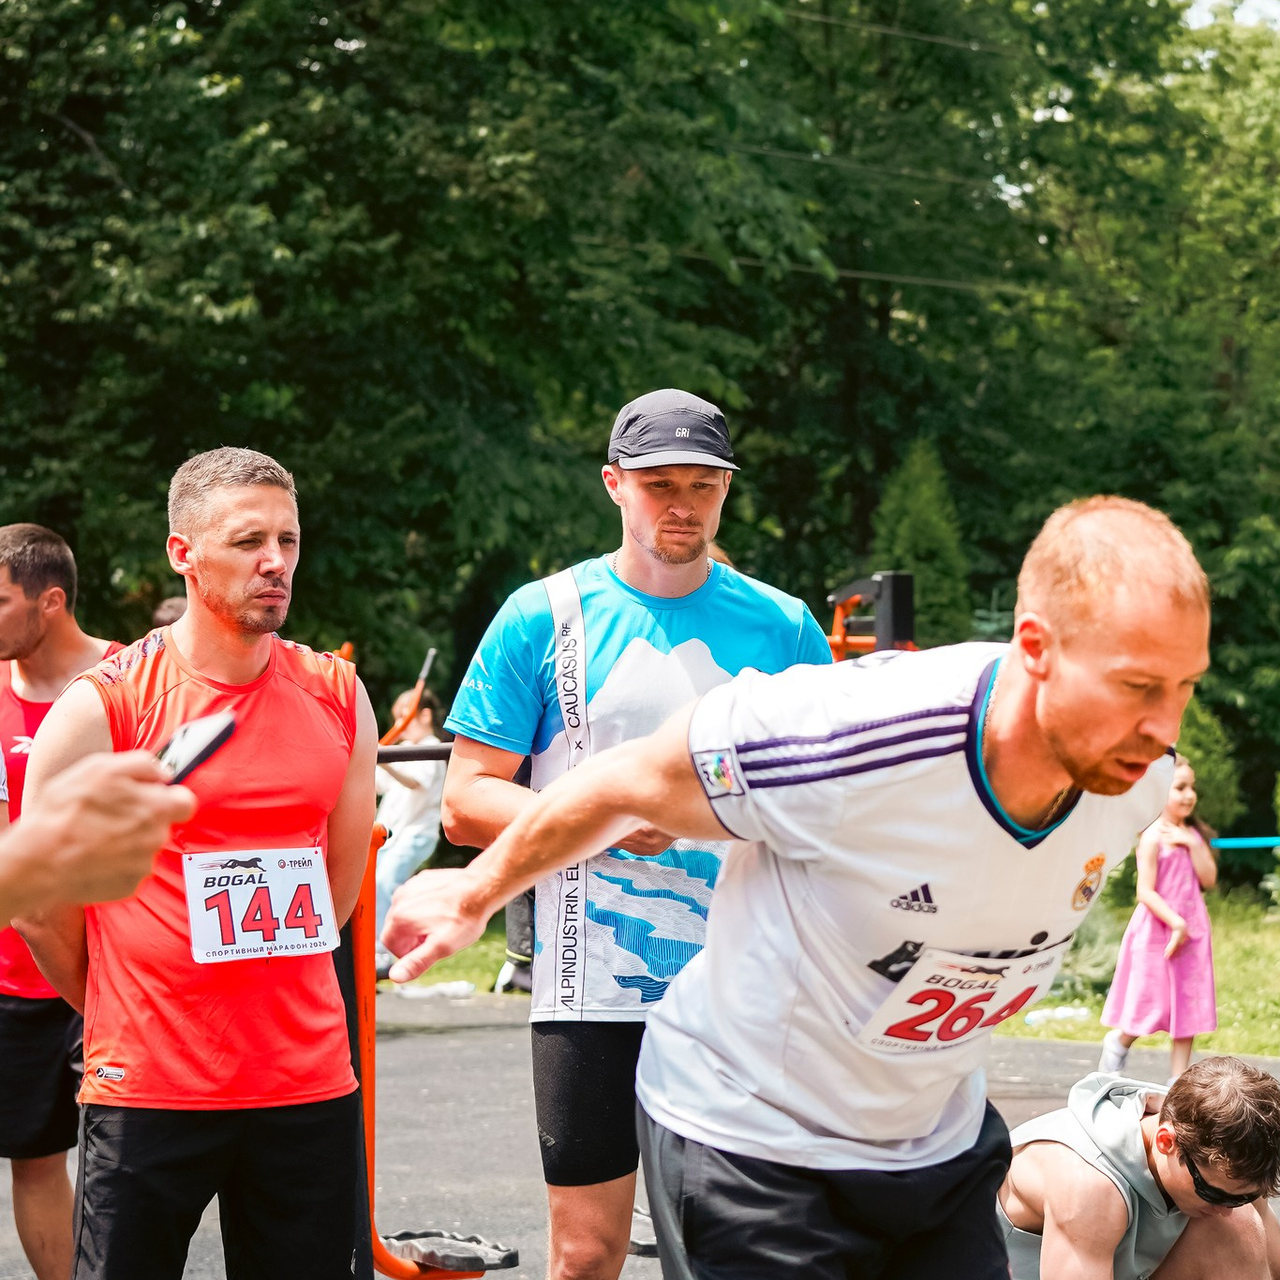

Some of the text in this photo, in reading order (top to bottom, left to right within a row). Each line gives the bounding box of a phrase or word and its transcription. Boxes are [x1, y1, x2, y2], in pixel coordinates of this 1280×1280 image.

[562, 622, 571, 637] RF
[562, 638, 581, 729] CAUCASUS
[203, 873, 268, 889] BOGAL
[890, 899, 938, 914] adidas
[204, 883, 323, 947] 144
[266, 943, 308, 953] МАРАФОН
[925, 973, 1000, 991] BOGAL
